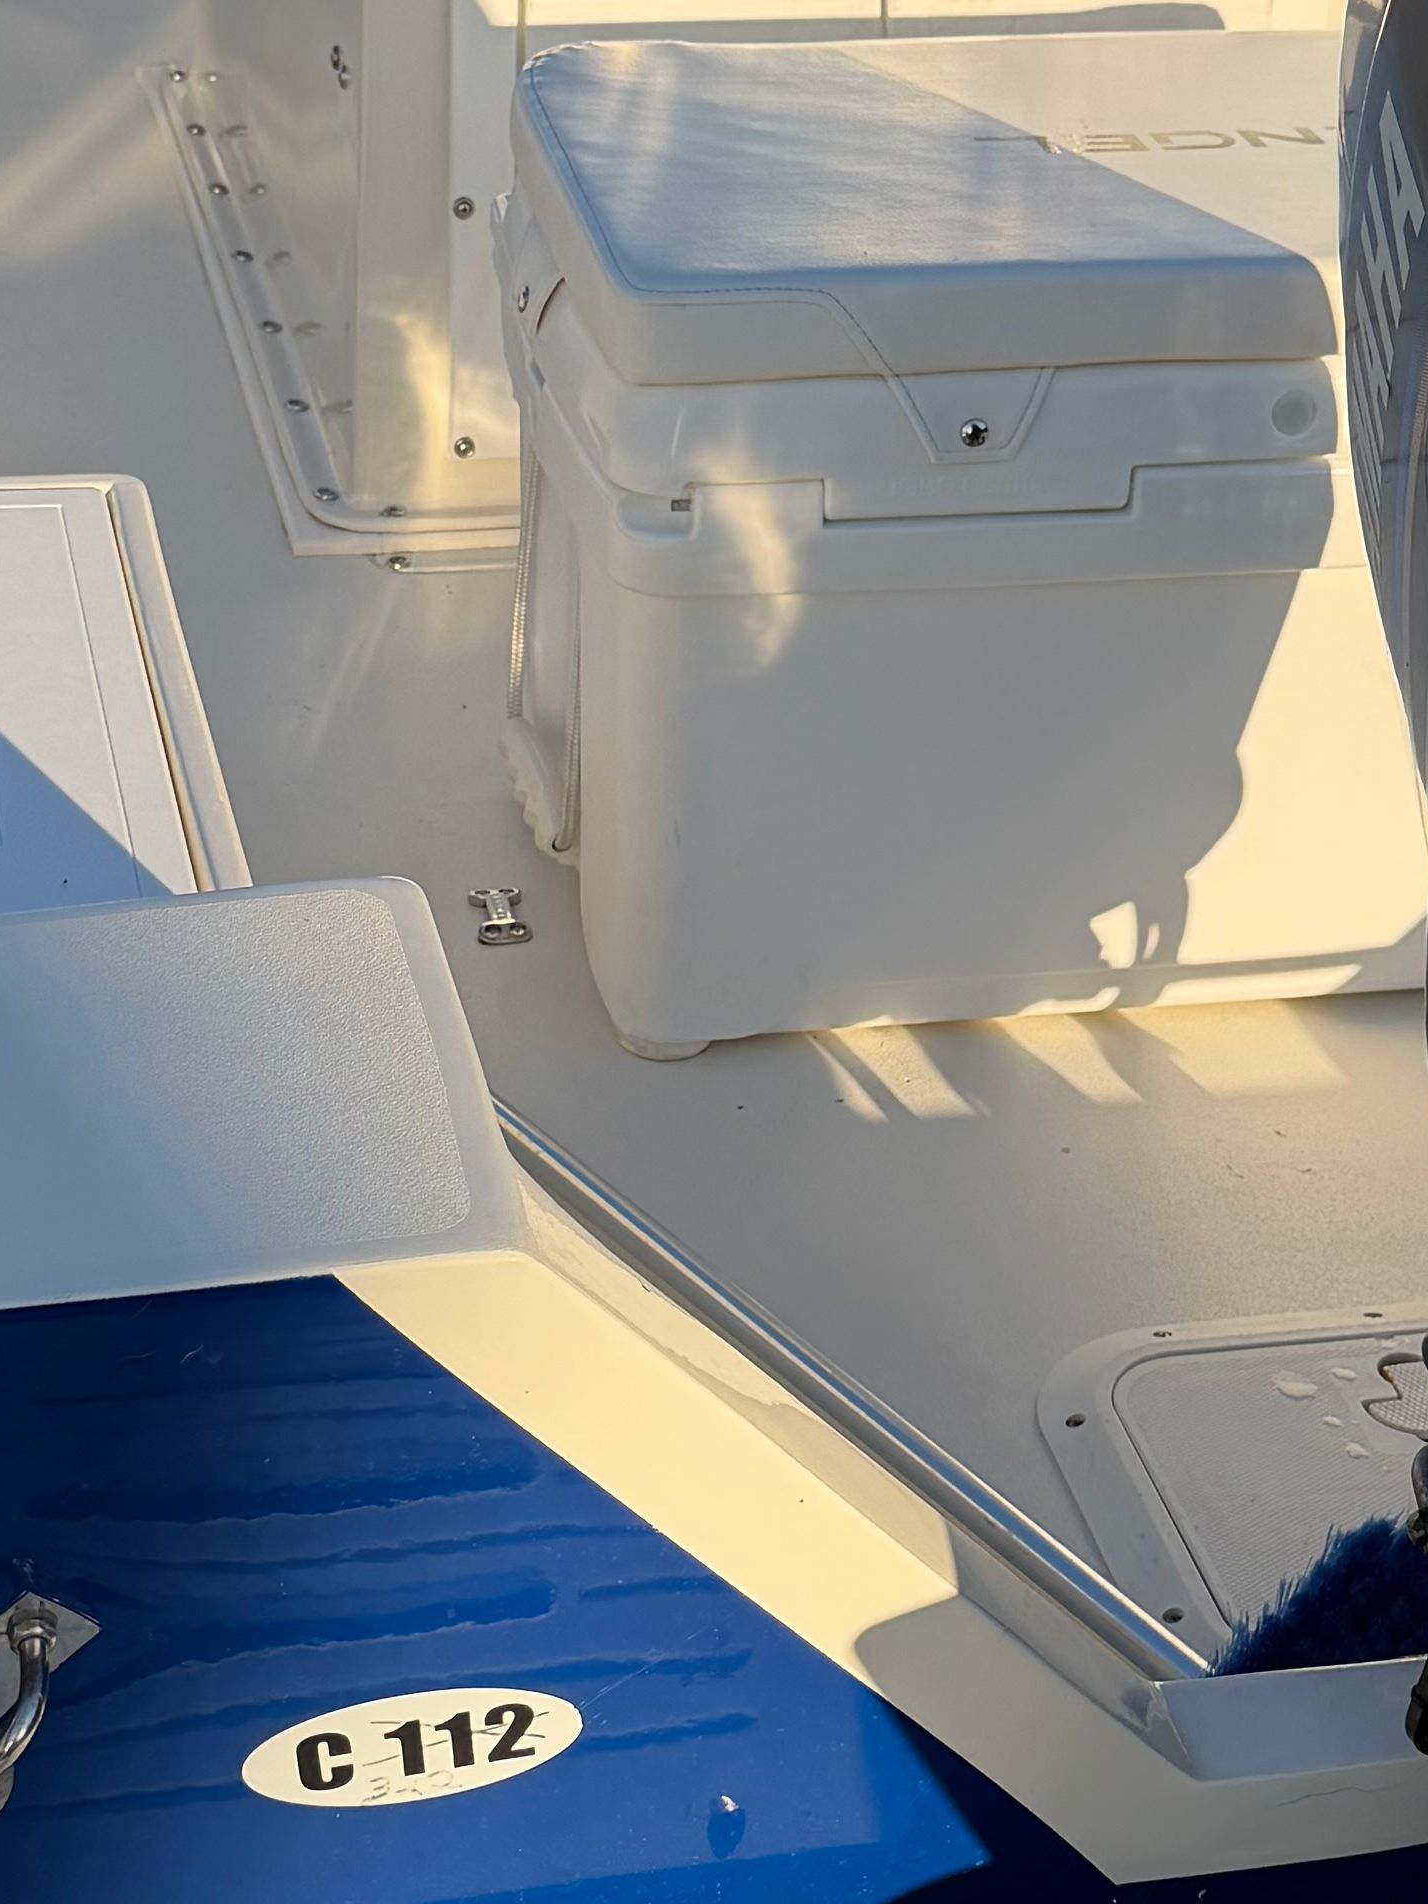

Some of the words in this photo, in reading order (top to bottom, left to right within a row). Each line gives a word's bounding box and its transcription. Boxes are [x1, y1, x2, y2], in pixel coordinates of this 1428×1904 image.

[972, 126, 1338, 153] NGEL
[1347, 89, 1426, 596] AMAHA
[295, 1732, 355, 1791] C
[383, 1702, 536, 1777] 112
